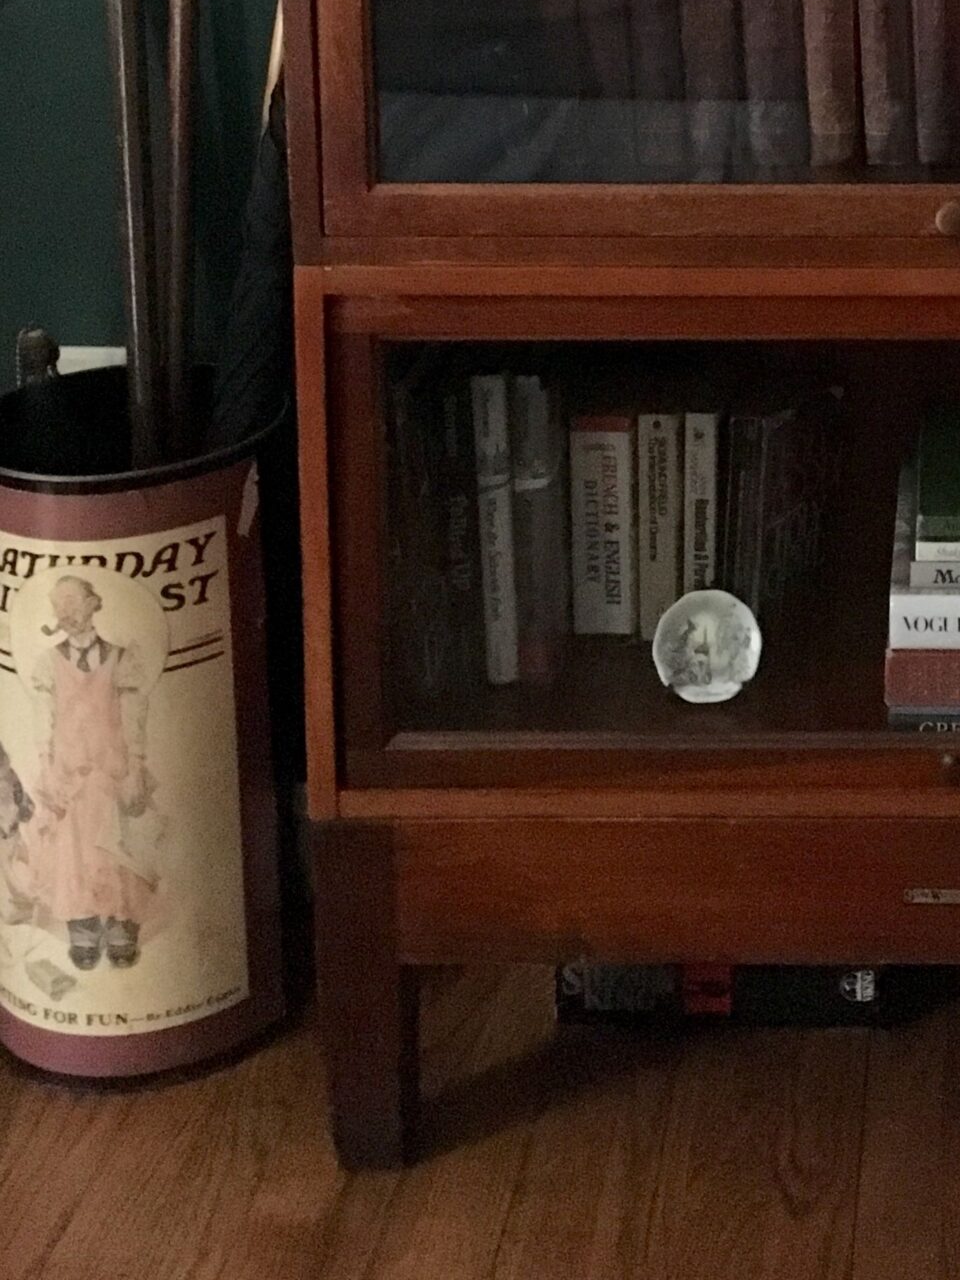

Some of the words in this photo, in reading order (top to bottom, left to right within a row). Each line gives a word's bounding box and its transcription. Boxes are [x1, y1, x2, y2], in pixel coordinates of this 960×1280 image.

[602, 455, 619, 516] FRENCH
[584, 480, 600, 583] DICTIONARY
[605, 522, 619, 533] &
[605, 540, 621, 606] ENGLISH
[43, 1007, 78, 1025] FOR
[166, 1001, 204, 1017] Eddie
